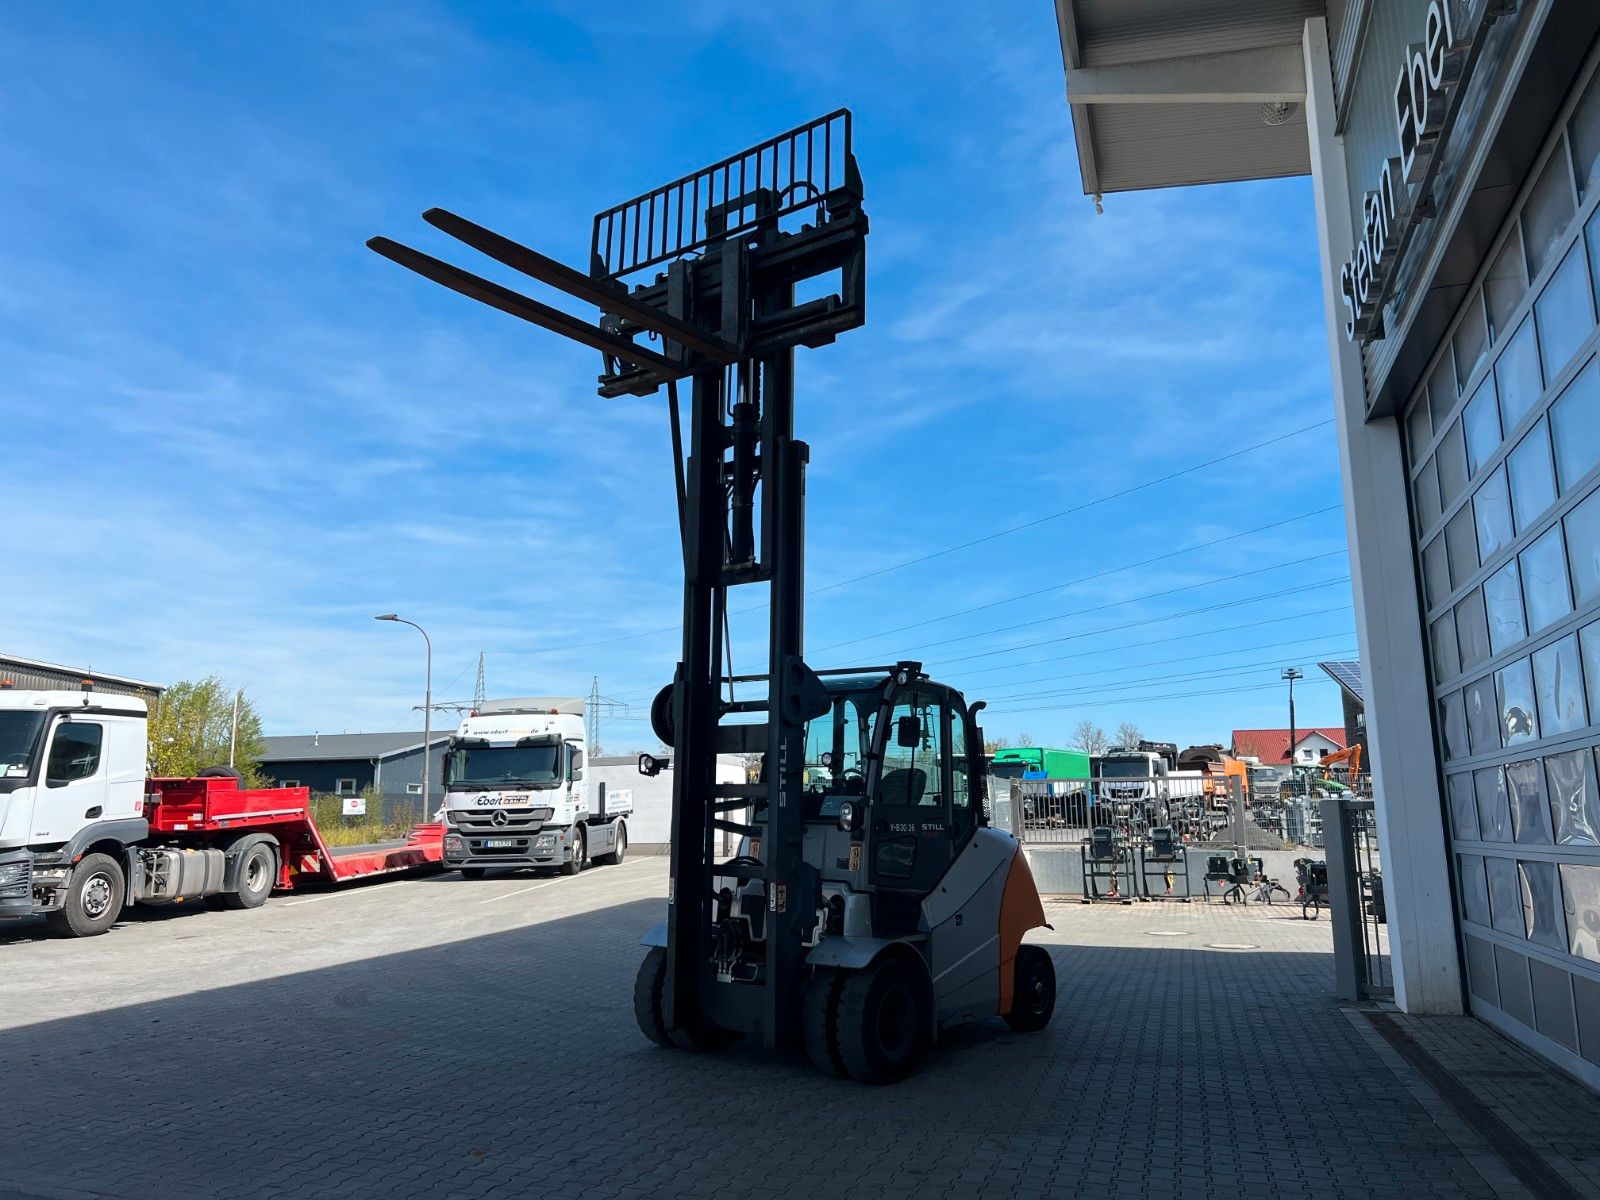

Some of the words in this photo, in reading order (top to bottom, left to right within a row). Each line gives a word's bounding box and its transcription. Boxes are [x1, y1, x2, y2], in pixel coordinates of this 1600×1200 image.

[1340, 157, 1395, 342] Stefan
[778, 737, 787, 807] STILL
[477, 795, 503, 806] Ebert
[921, 823, 945, 831] STILL
